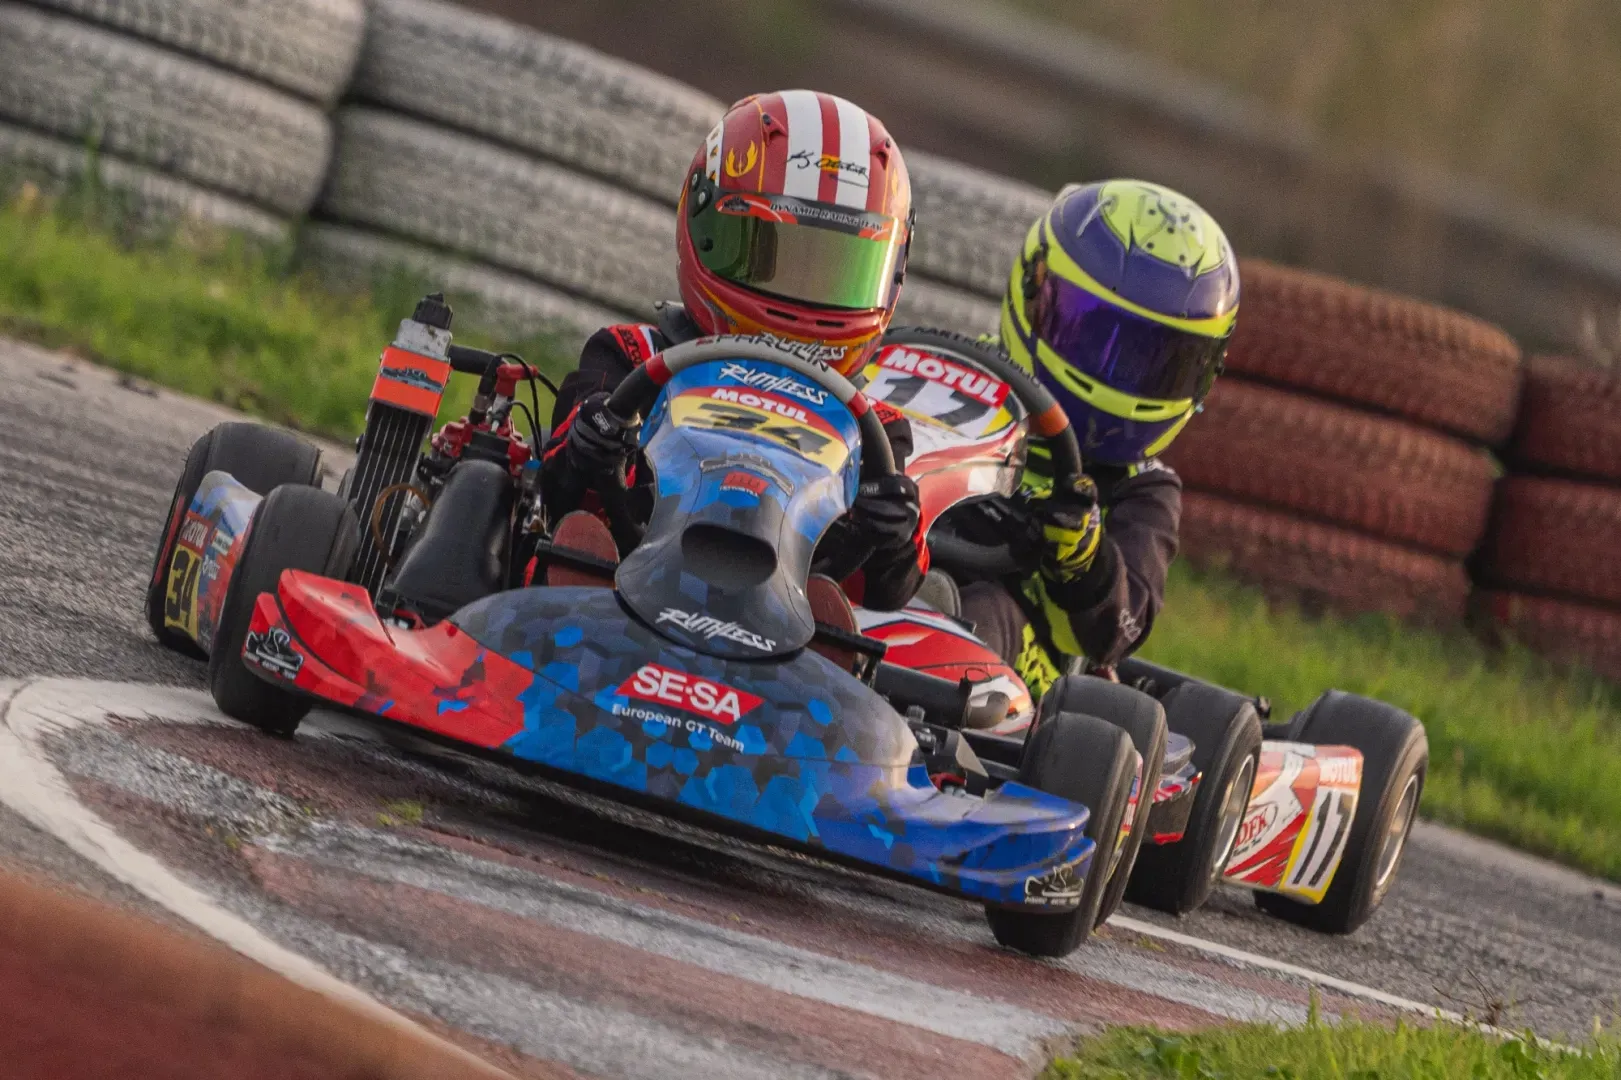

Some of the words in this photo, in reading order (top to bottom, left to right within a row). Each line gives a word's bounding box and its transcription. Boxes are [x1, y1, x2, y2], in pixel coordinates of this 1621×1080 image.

[718, 361, 829, 406] RUTHLESS
[883, 348, 1002, 402] MOTUL
[711, 388, 809, 424] MOTUL
[655, 607, 777, 652] RUTHLESS
[612, 704, 682, 728] European
[685, 718, 707, 736] GT
[709, 725, 745, 754] Team
[1292, 790, 1356, 888] 11
